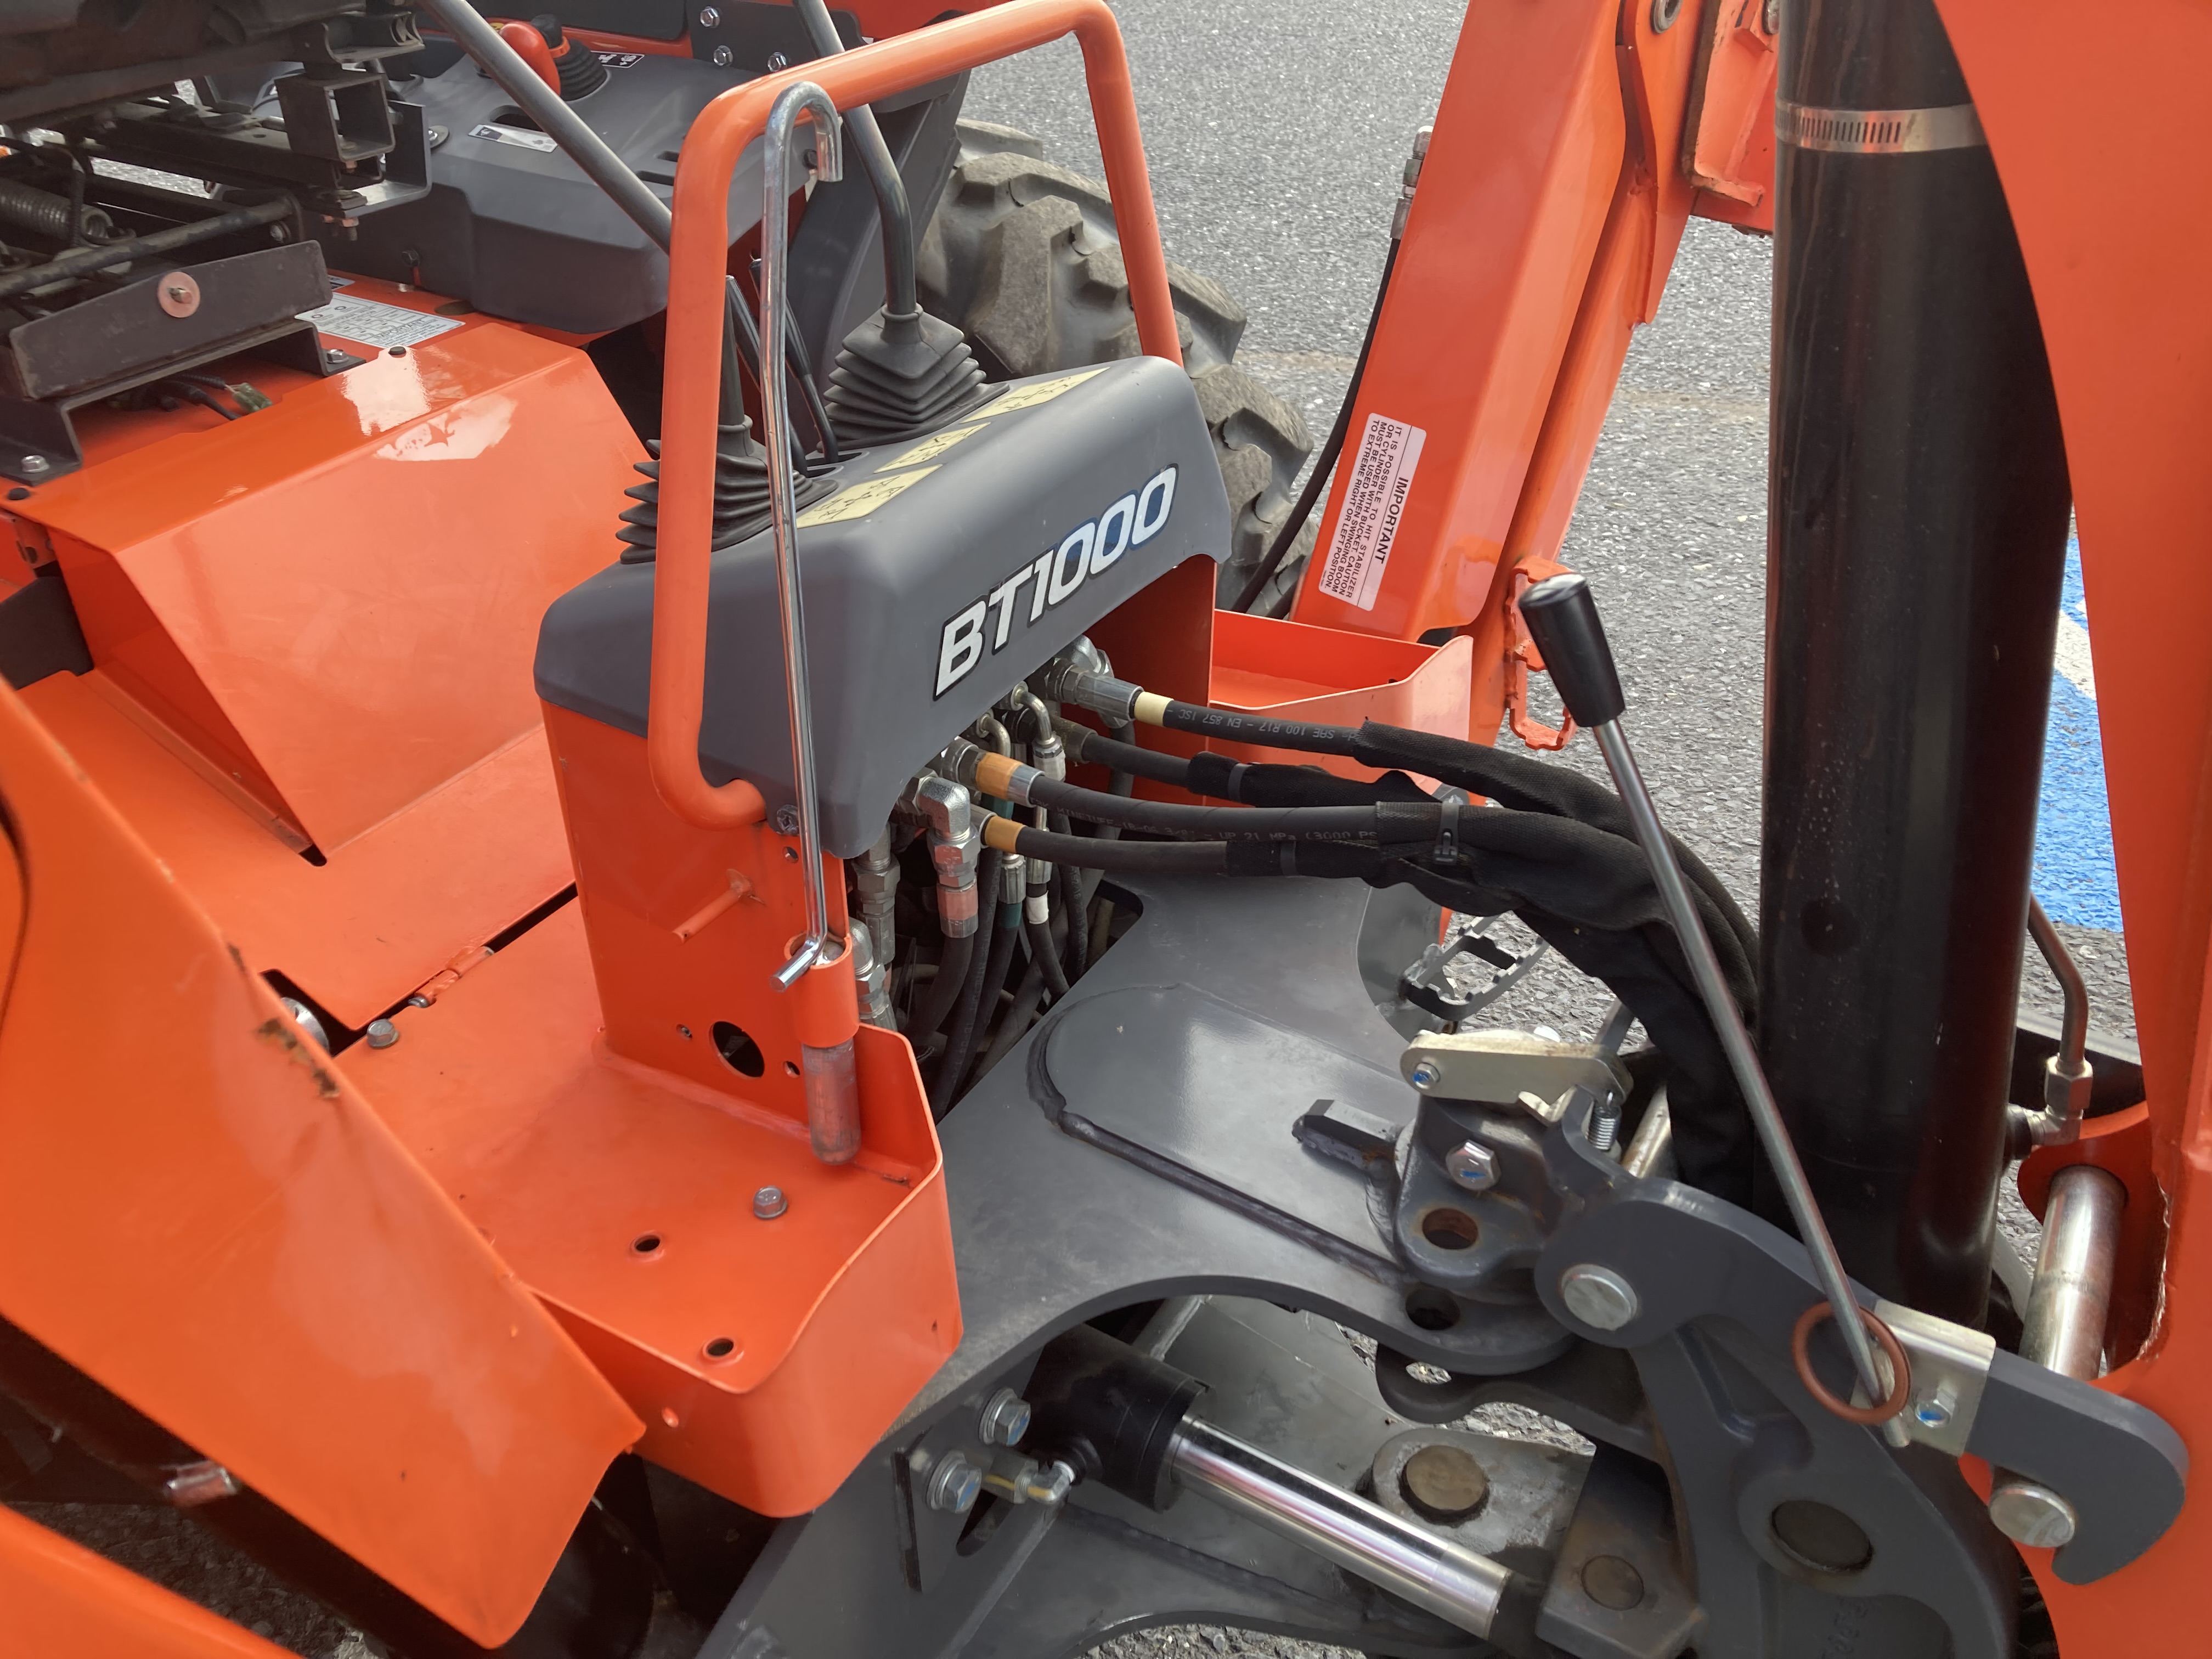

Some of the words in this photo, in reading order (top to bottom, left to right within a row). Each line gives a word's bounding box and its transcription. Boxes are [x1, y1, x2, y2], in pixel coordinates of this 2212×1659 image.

[1371, 420, 1380, 432] TO
[1374, 421, 1387, 449] MUST
[1385, 424, 1395, 439] OR
[1395, 426, 1403, 437] IT
[1357, 433, 1375, 477] EXTREME
[1370, 449, 1379, 463] BE
[1390, 440, 1398, 450] IS
[1370, 441, 1390, 487] CYLINDER
[1362, 464, 1375, 489] USED
[1374, 454, 1394, 504] POSSIBLE
[1349, 478, 1362, 507] RIGHT
[1363, 490, 1375, 514] WITH
[1344, 508, 1353, 522] OR
[1353, 492, 1367, 518] WHEN
[1369, 508, 1379, 521] TO
[1363, 524, 1373, 541] HIT
[1374, 477, 1409, 565] IMPORTANT
[1338, 523, 1349, 545] LEFT
[1340, 519, 1358, 564] SWINGING
[1324, 546, 1342, 589] POSITION.
[1338, 556, 1355, 596] CAUTION
[1345, 544, 1367, 598] STABILIZER
[934, 465, 1178, 698] BT1000
[1331, 566, 1345, 593] BOOM
[1203, 713, 1222, 725] 857
[1227, 717, 1242, 729] EN
[1259, 721, 1282, 733] R17
[1286, 725, 1305, 736] 100
[1312, 727, 1335, 739] SAE
[1269, 832, 1297, 841] MPa
